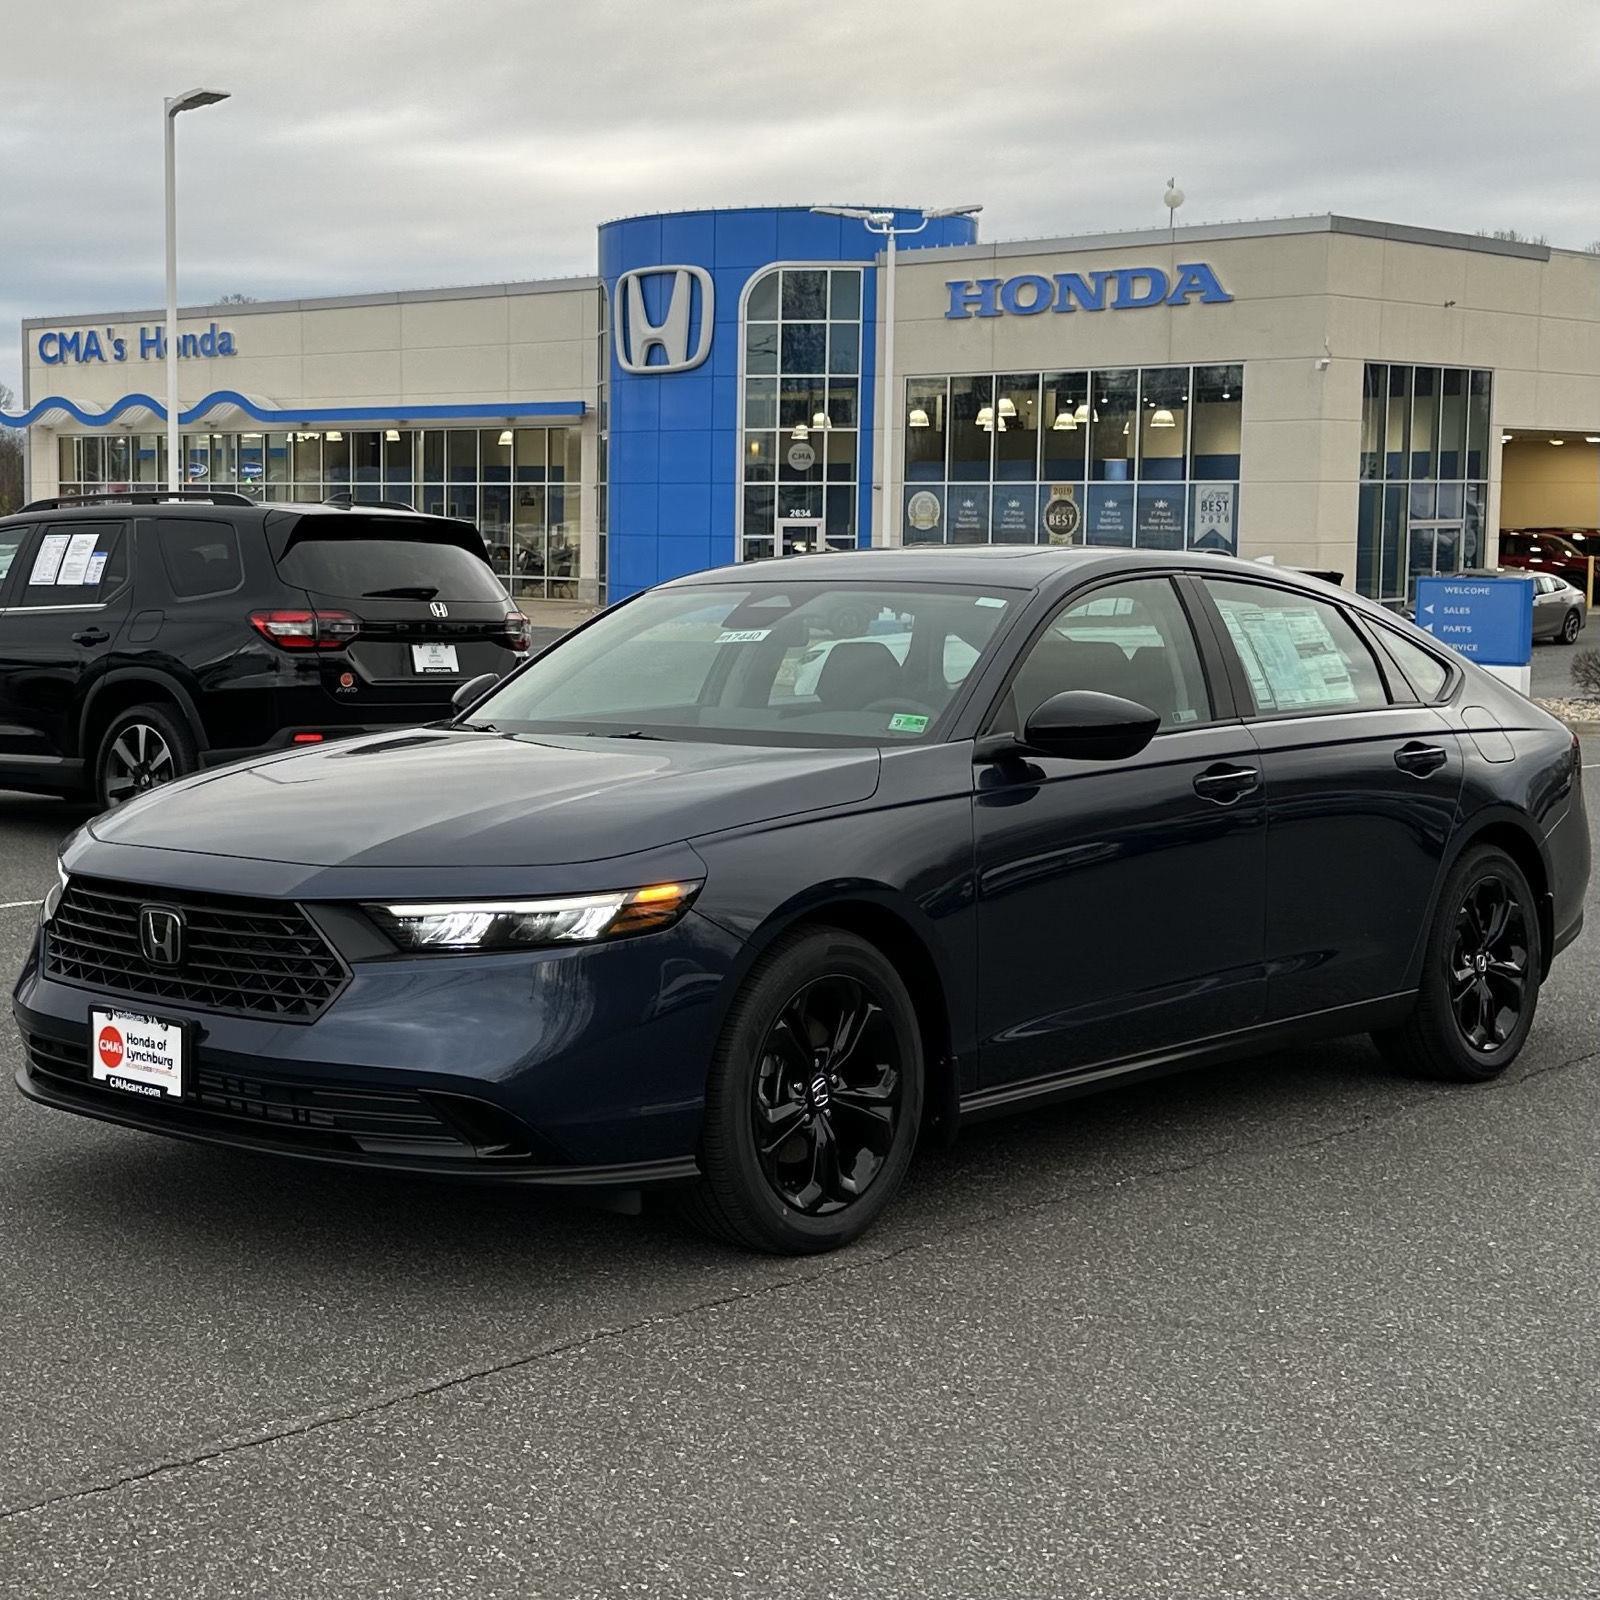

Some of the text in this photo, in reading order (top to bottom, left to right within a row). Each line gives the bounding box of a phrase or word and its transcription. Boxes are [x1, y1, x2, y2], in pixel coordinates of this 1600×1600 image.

[945, 263, 1233, 319] HONDA
[38, 328, 128, 364] CMA's
[791, 452, 811, 460] CMA
[1201, 500, 1229, 512] BEST
[1048, 514, 1073, 526] BEST
[1444, 586, 1490, 595] WELCOME
[1443, 606, 1470, 615] SALES
[1443, 625, 1472, 633] PARTS
[1447, 643, 1478, 651] ERVICE
[127, 1032, 166, 1051] Honda of
[127, 1047, 173, 1070] Lynchburg
[110, 1077, 160, 1097] CMAcars.com
